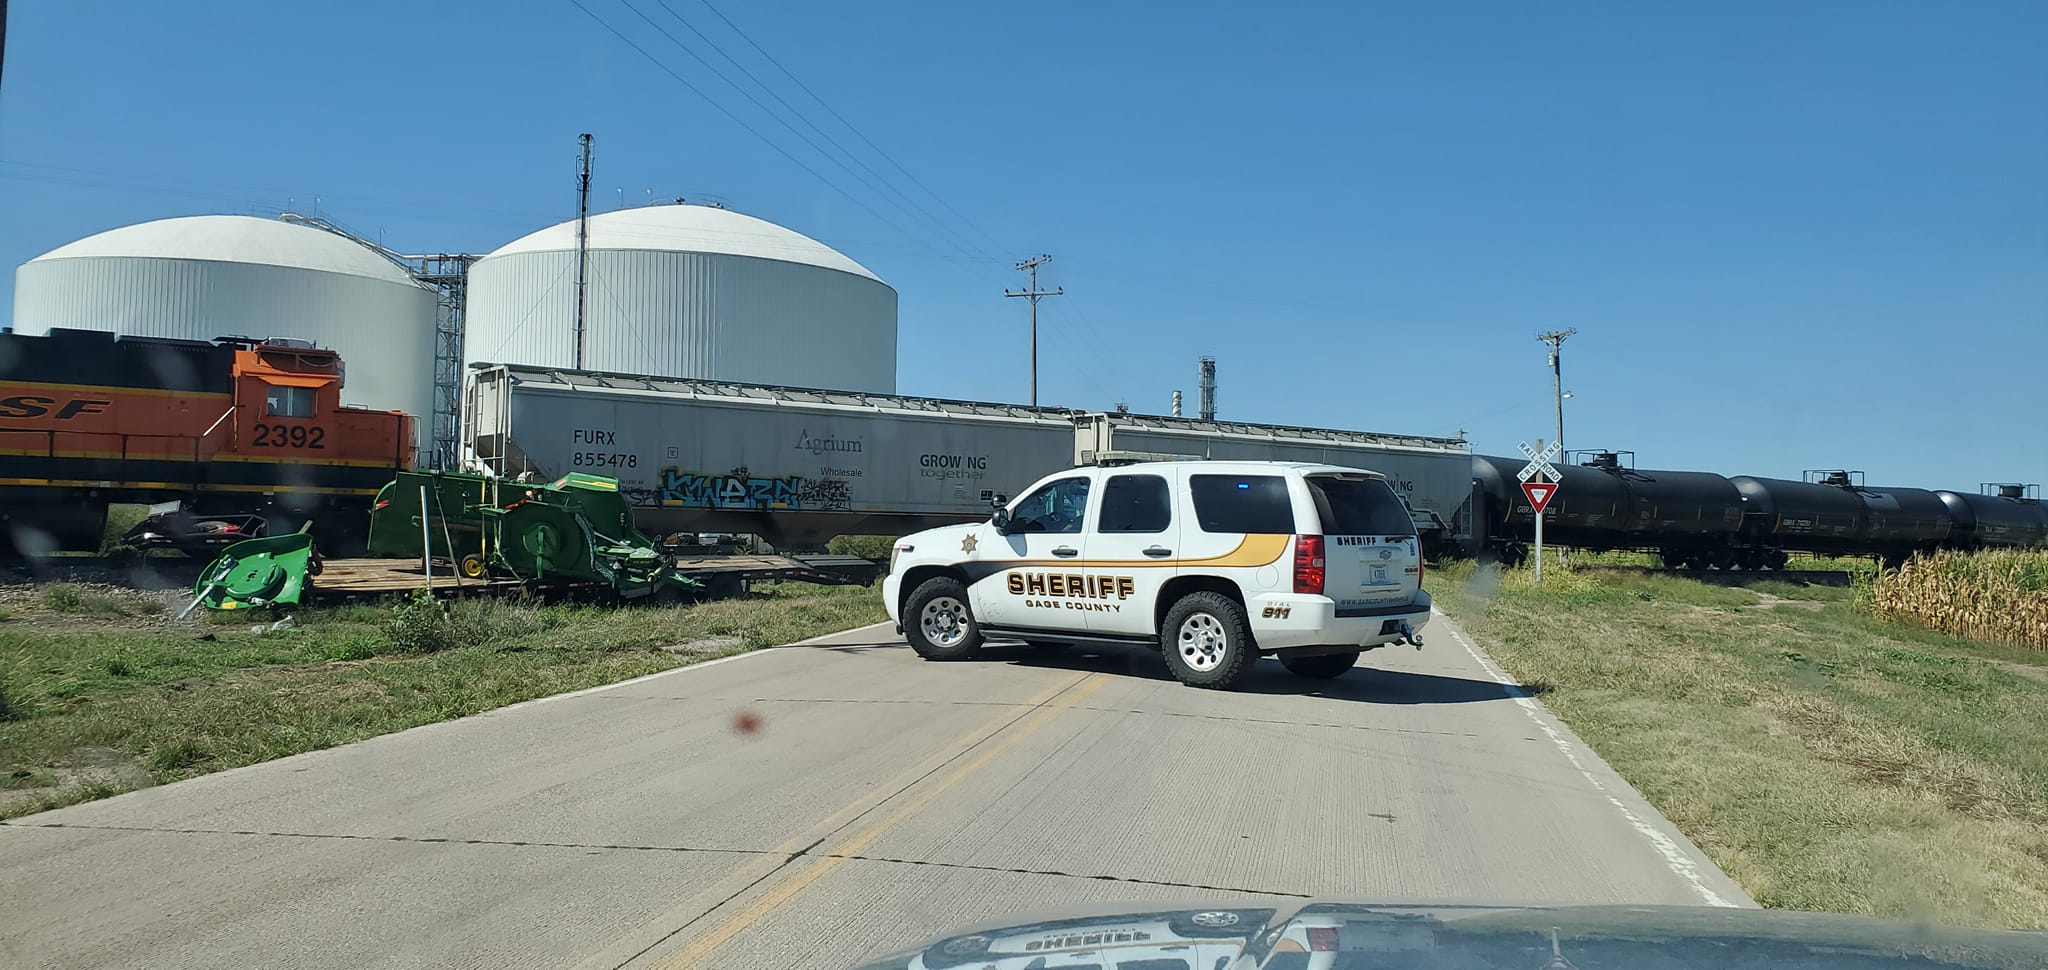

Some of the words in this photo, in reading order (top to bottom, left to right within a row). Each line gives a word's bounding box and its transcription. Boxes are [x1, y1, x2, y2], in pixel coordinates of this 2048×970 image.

[252, 423, 325, 448] 2392
[574, 429, 615, 445] FURX
[795, 428, 863, 455] Agrium
[573, 452, 638, 468] 855478
[1519, 442, 1560, 480] CROSSING
[1519, 442, 1537, 460] RAIL
[1541, 462, 1560, 481] ROAD
[820, 467, 863, 477] Wholesale
[920, 469, 984, 480] together
[1336, 537, 1377, 546] SHERIFF
[1007, 572, 1135, 600] SHERIFF
[1025, 600, 1060, 608] GAGE
[1065, 602, 1121, 612] COUNTY
[1262, 607, 1291, 619] 911
